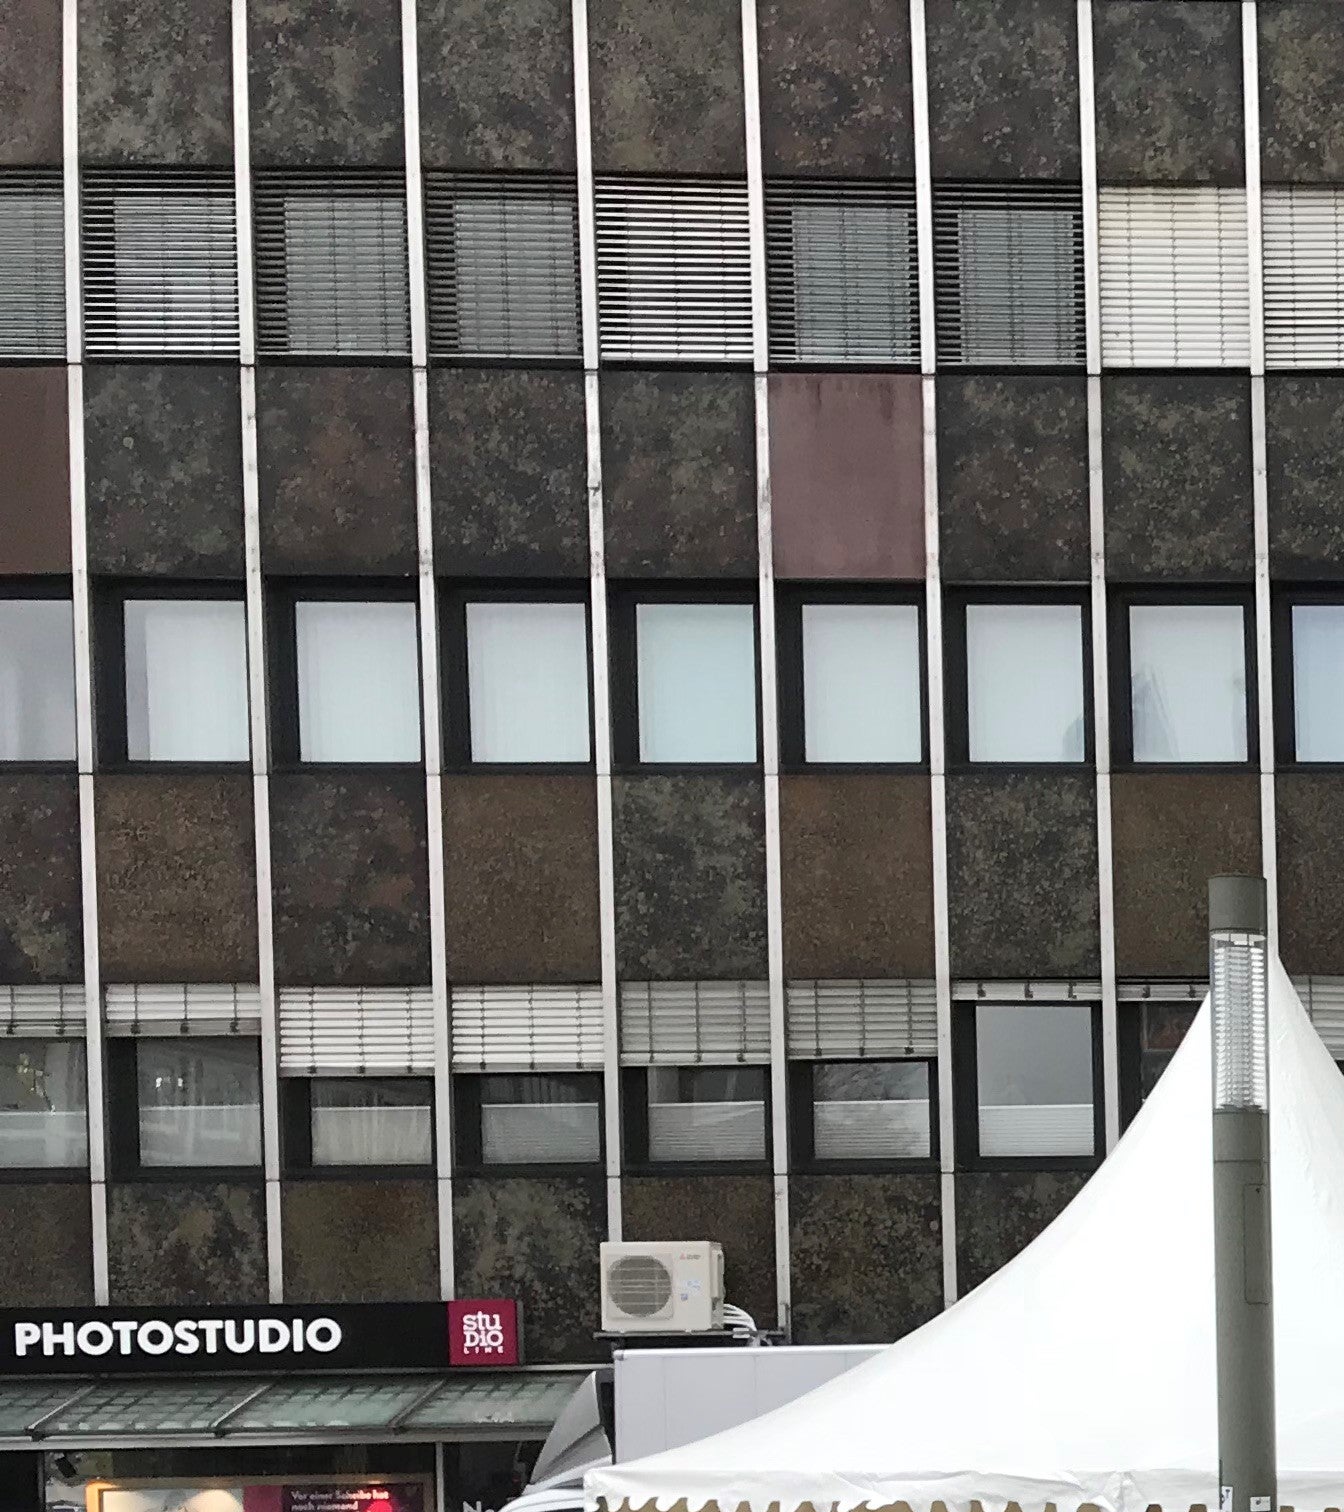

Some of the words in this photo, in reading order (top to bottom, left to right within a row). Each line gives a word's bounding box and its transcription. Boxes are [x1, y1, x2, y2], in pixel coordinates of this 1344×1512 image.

[463, 1310, 503, 1331] stu
[14, 1317, 343, 1357] PHOTOSTUDIO
[463, 1346, 504, 1355] LINE
[291, 1490, 308, 1500] Vor
[309, 1491, 333, 1500] einer
[291, 1501, 315, 1511] noch
[316, 1500, 359, 1511] niemand
